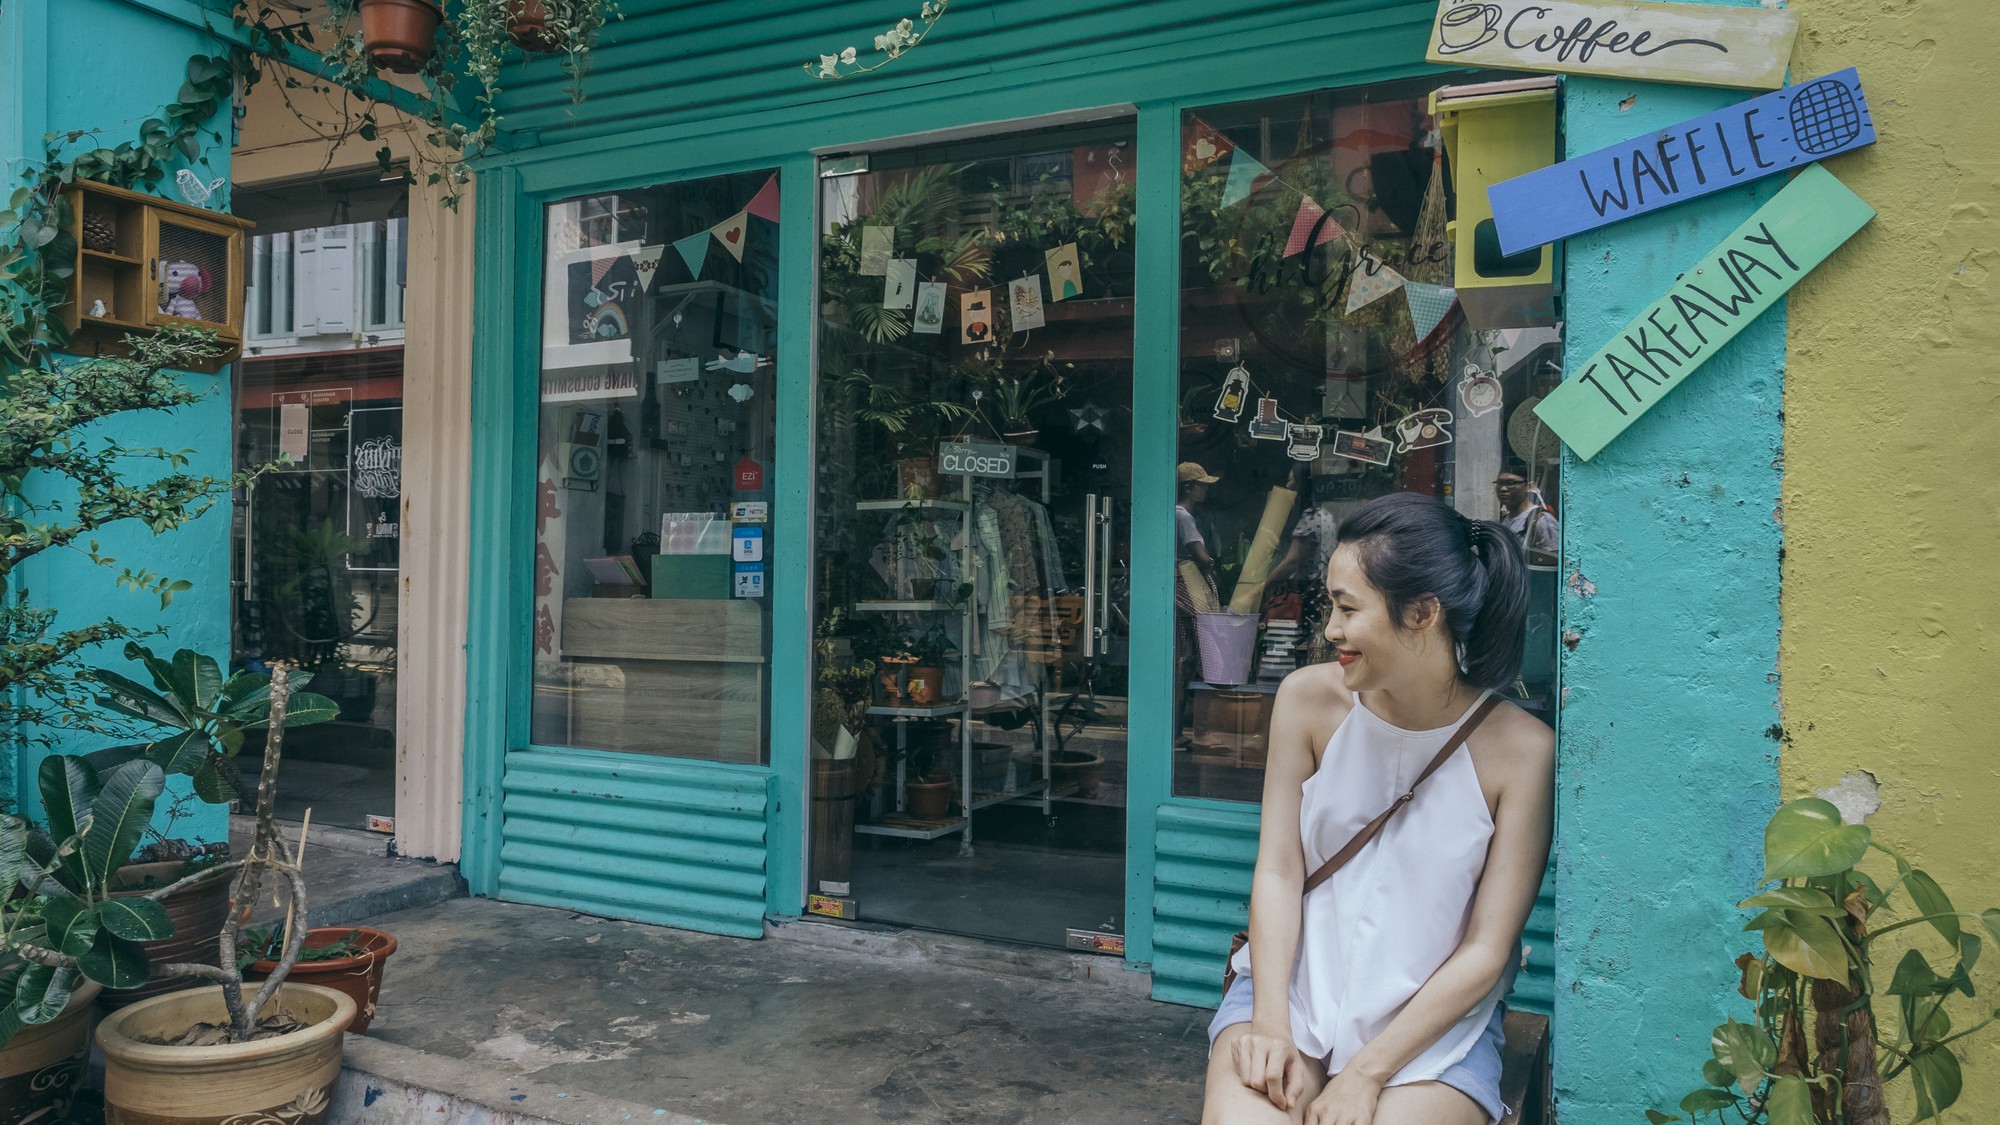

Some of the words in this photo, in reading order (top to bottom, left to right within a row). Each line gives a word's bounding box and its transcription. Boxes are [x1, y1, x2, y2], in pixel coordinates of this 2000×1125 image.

[1503, 5, 1729, 63] Coffee
[1579, 108, 1775, 217] WAFFLE
[1579, 222, 1800, 416] TAKEAWAY
[943, 454, 1010, 474] CLOSED
